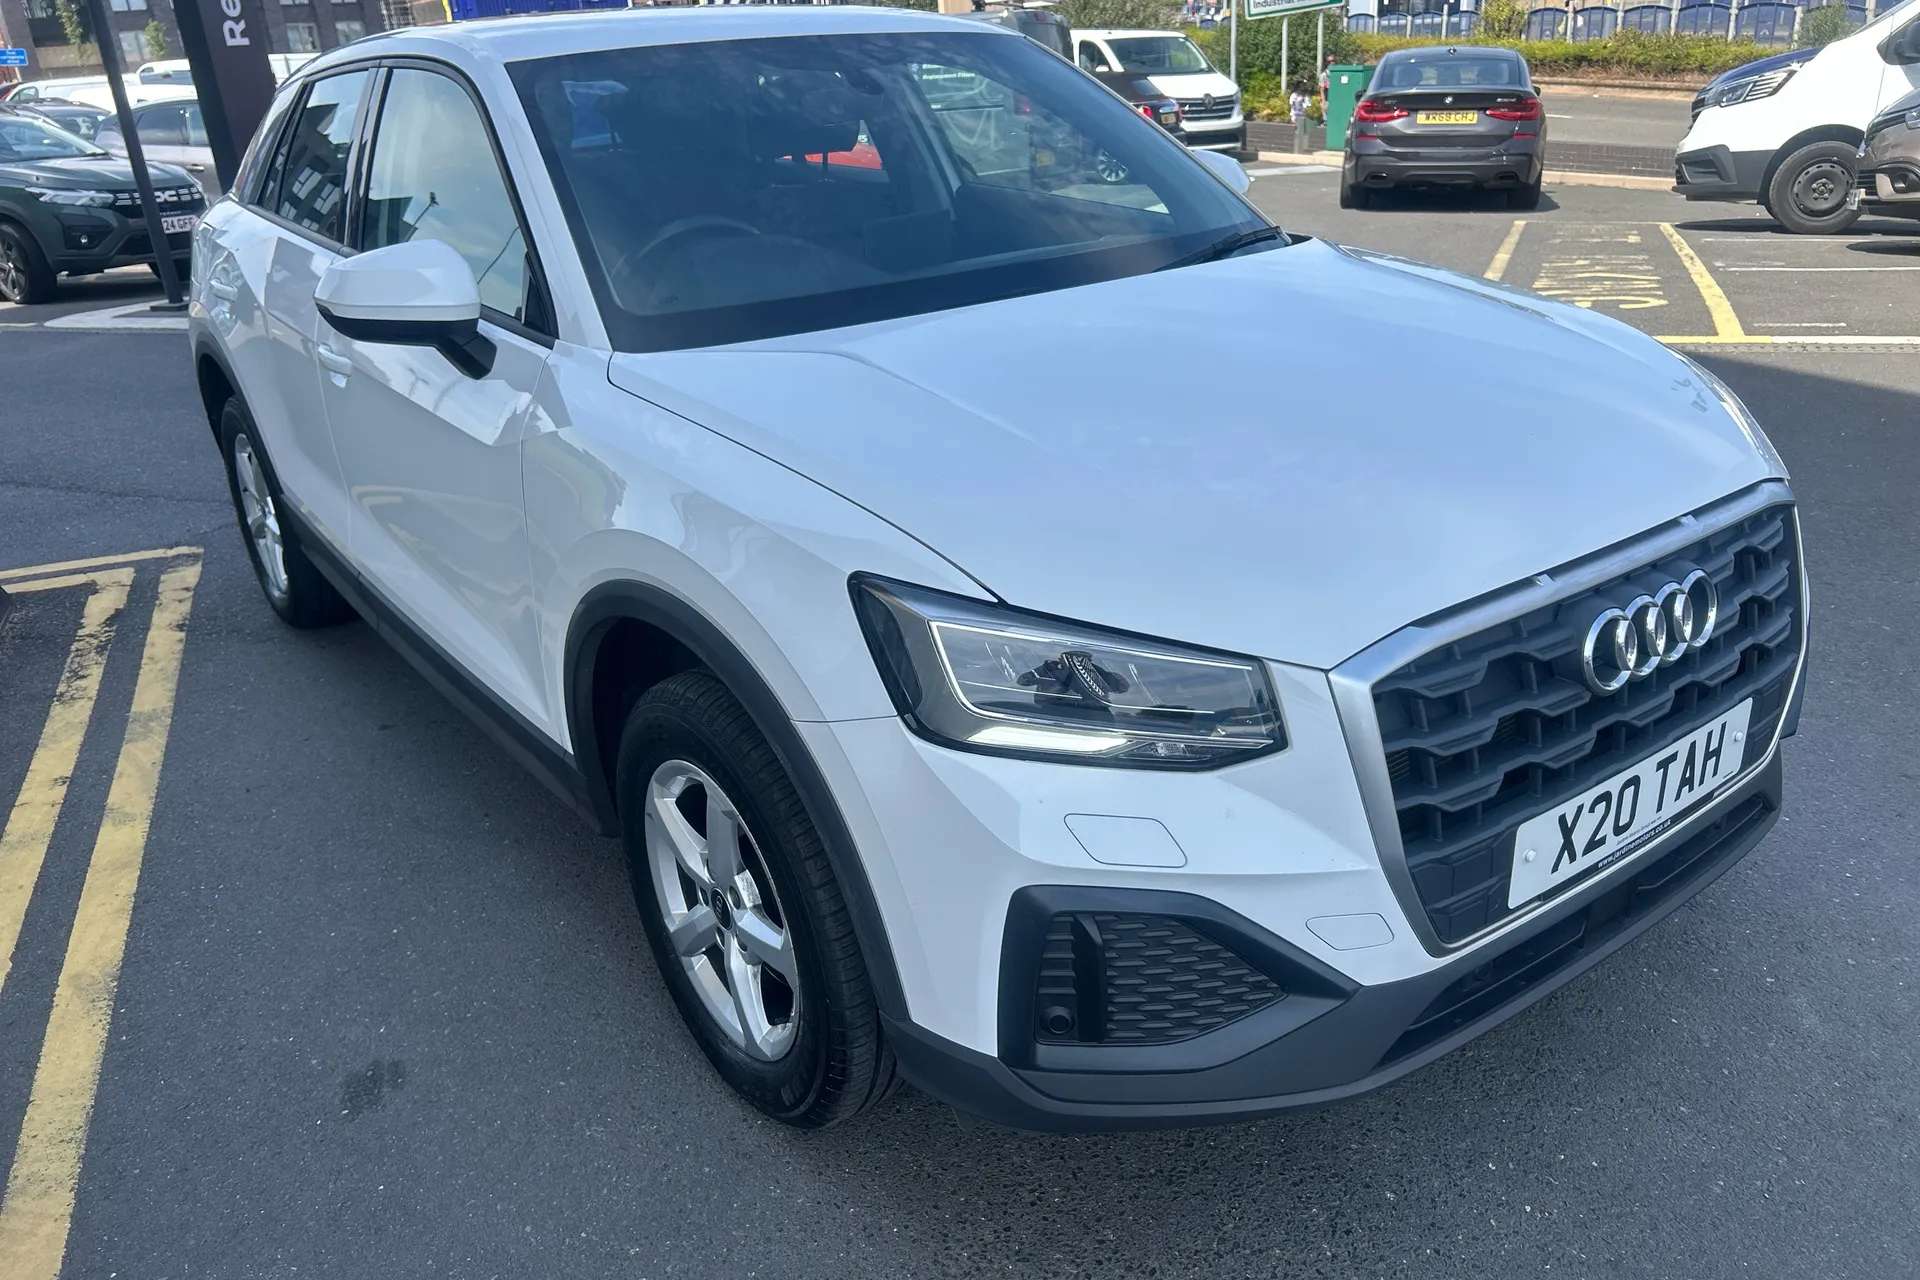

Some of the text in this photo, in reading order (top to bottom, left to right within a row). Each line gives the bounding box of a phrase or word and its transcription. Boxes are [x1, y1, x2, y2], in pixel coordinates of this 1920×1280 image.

[163, 219, 176, 231] 24
[1551, 721, 1727, 875] X20 TAH
